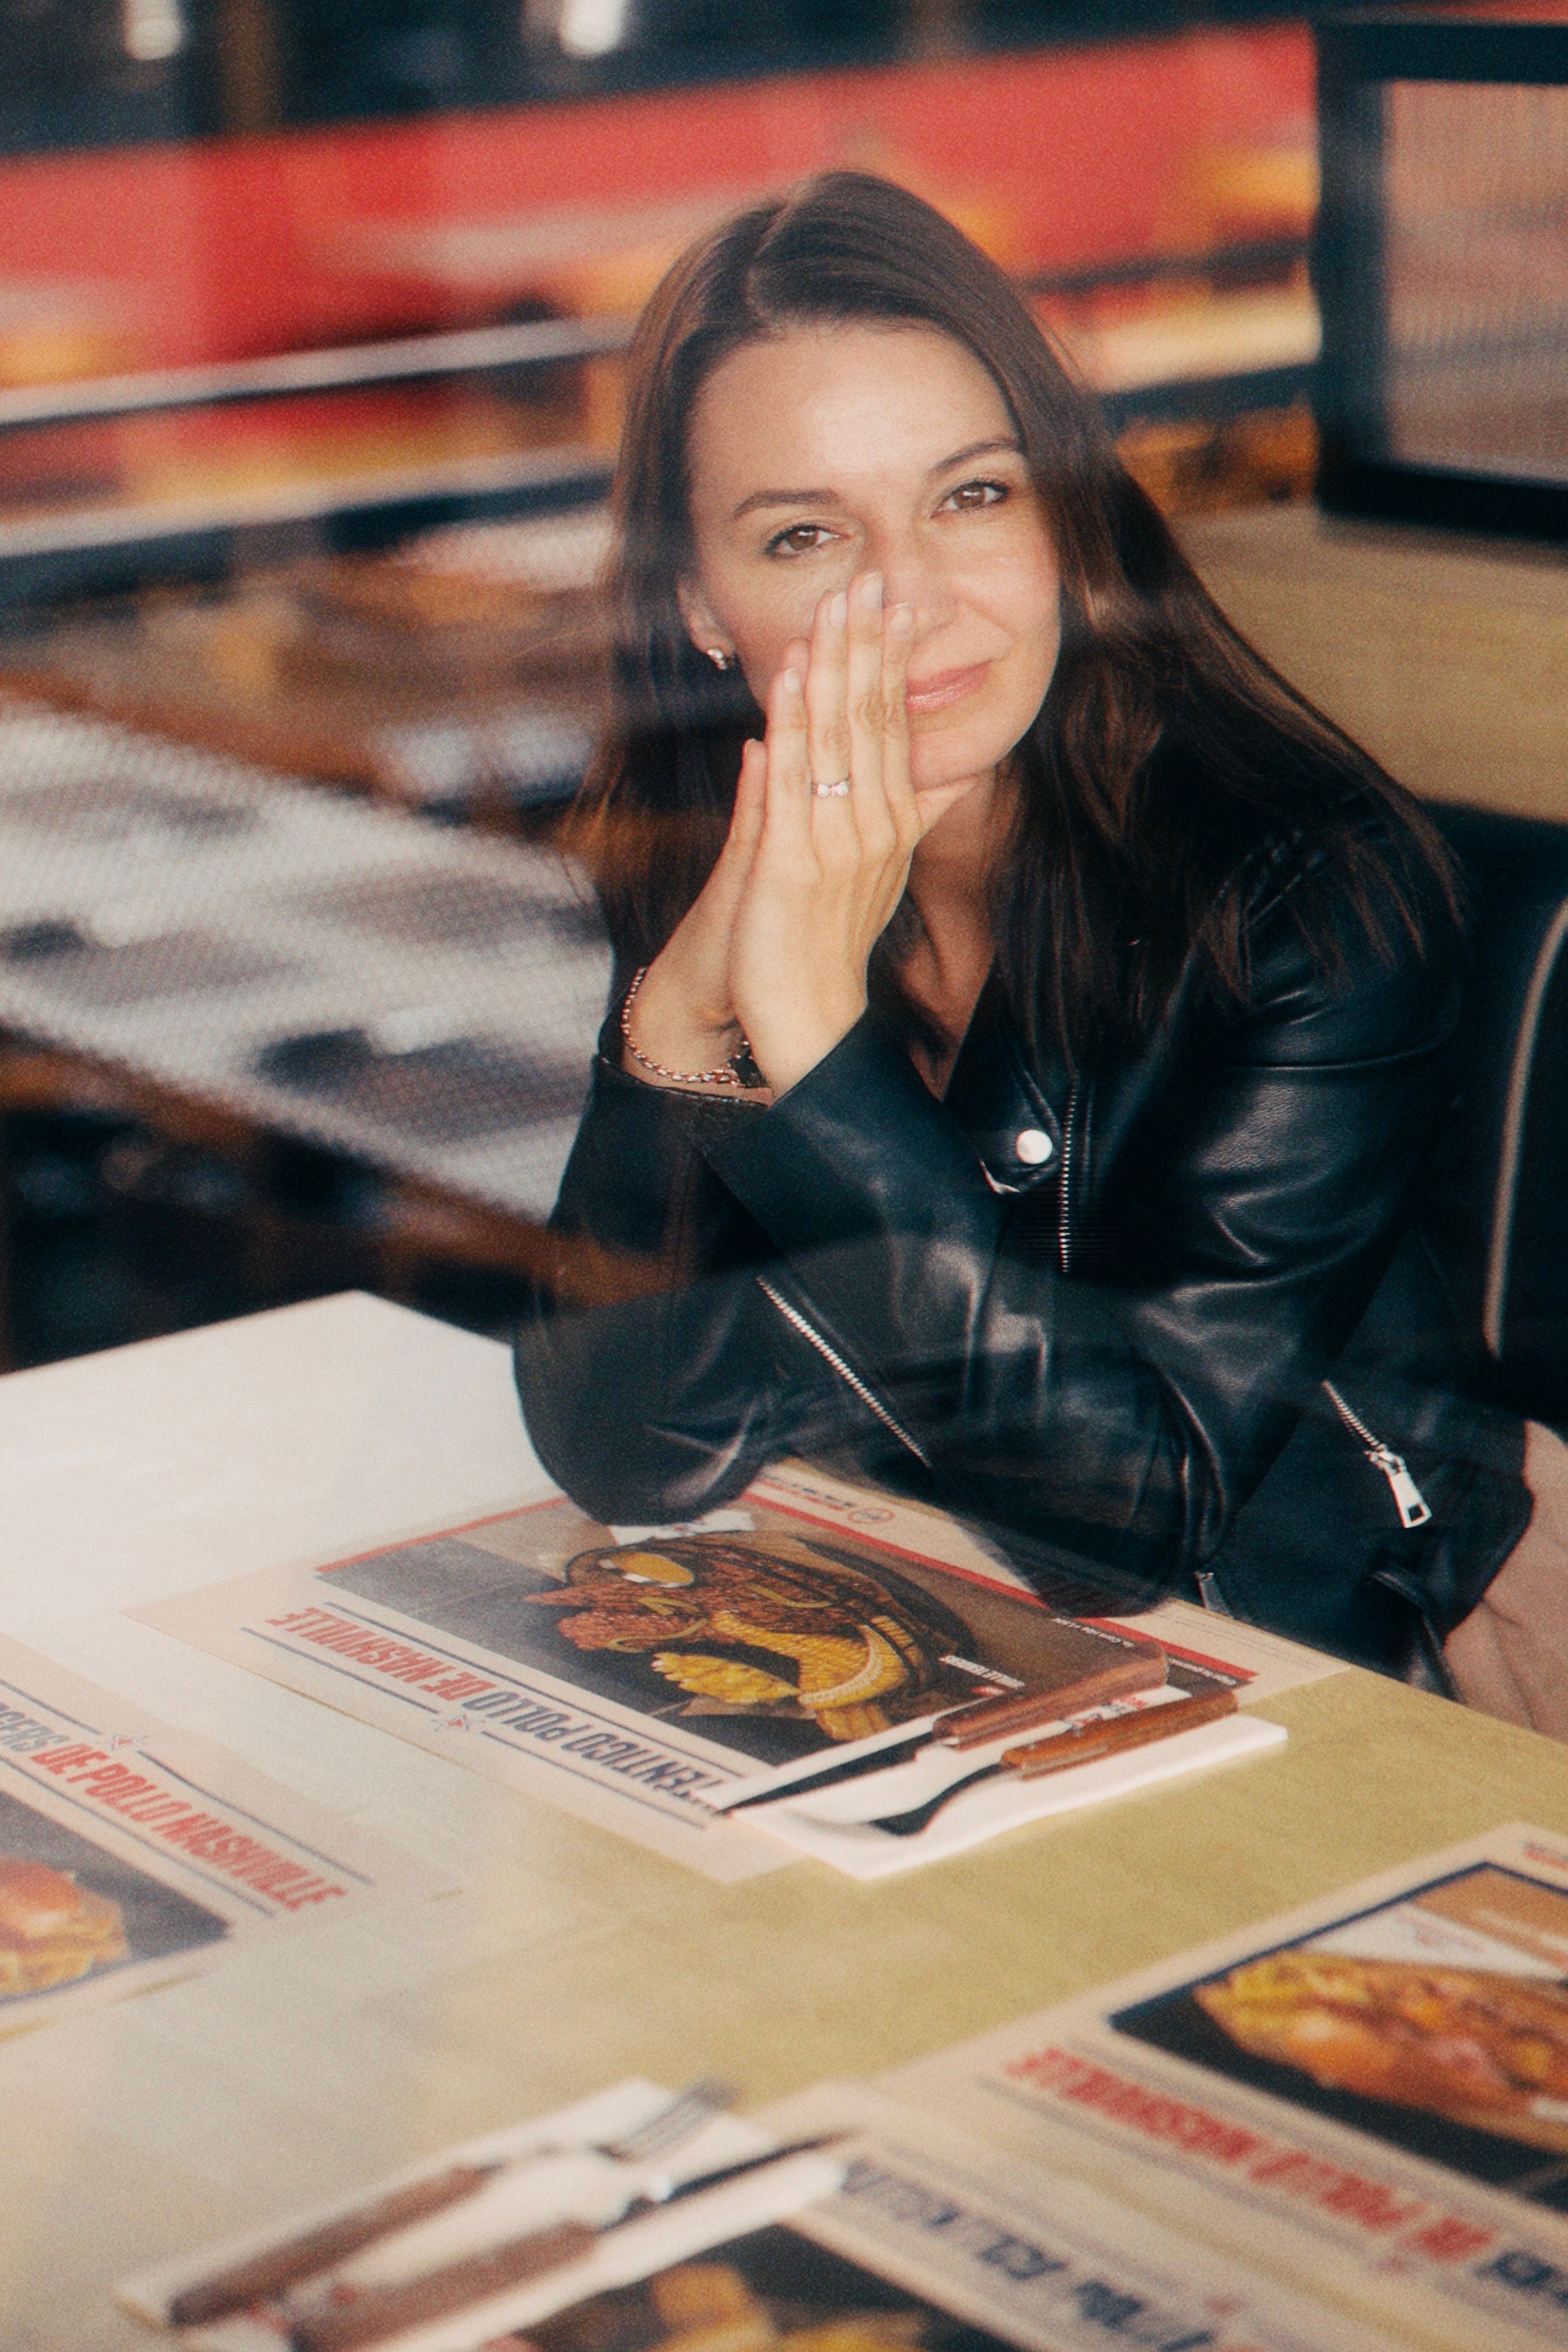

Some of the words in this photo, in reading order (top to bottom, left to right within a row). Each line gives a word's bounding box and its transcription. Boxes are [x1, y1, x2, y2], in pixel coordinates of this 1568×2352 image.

[265, 1606, 454, 1684] NASHVILLE
[418, 1672, 496, 1702] DE
[461, 1690, 587, 1746] POLLO
[29, 1742, 110, 1775] DE
[66, 1761, 194, 1824] POLLO
[150, 1812, 348, 1912] NASHVILLE
